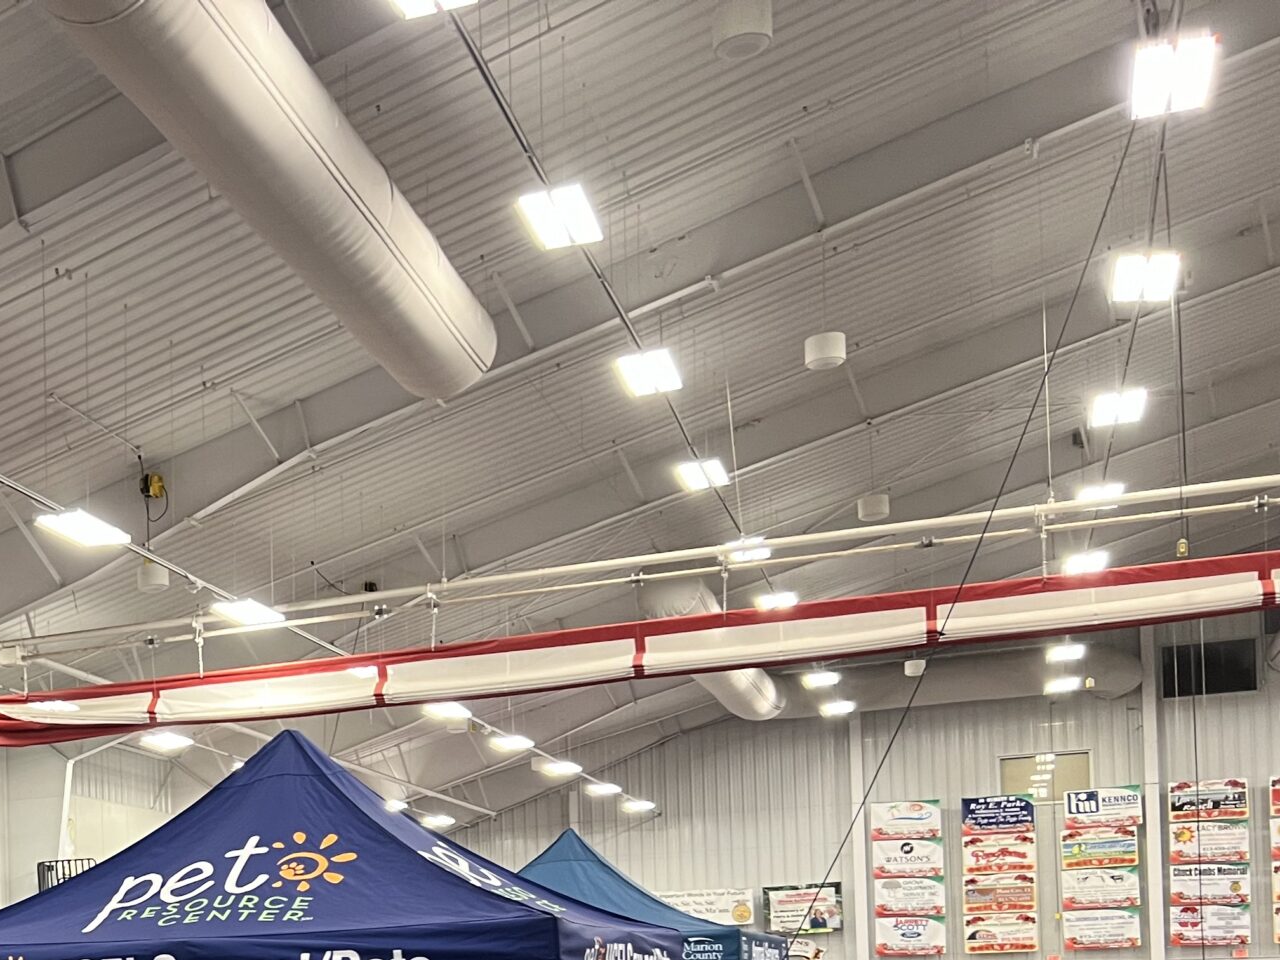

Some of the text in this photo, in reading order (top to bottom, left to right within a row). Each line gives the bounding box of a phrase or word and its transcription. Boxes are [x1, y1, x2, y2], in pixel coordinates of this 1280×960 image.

[1101, 794, 1139, 803] KENNCO
[1000, 800, 1026, 808] Parke
[1173, 867, 1193, 876] Chuck
[1217, 866, 1248, 875] Memorial
[81, 834, 270, 934] pet
[117, 895, 314, 922] RESOURCE
[157, 909, 306, 927] CENTER
[683, 942, 723, 952] Marion
[682, 950, 724, 960] County
